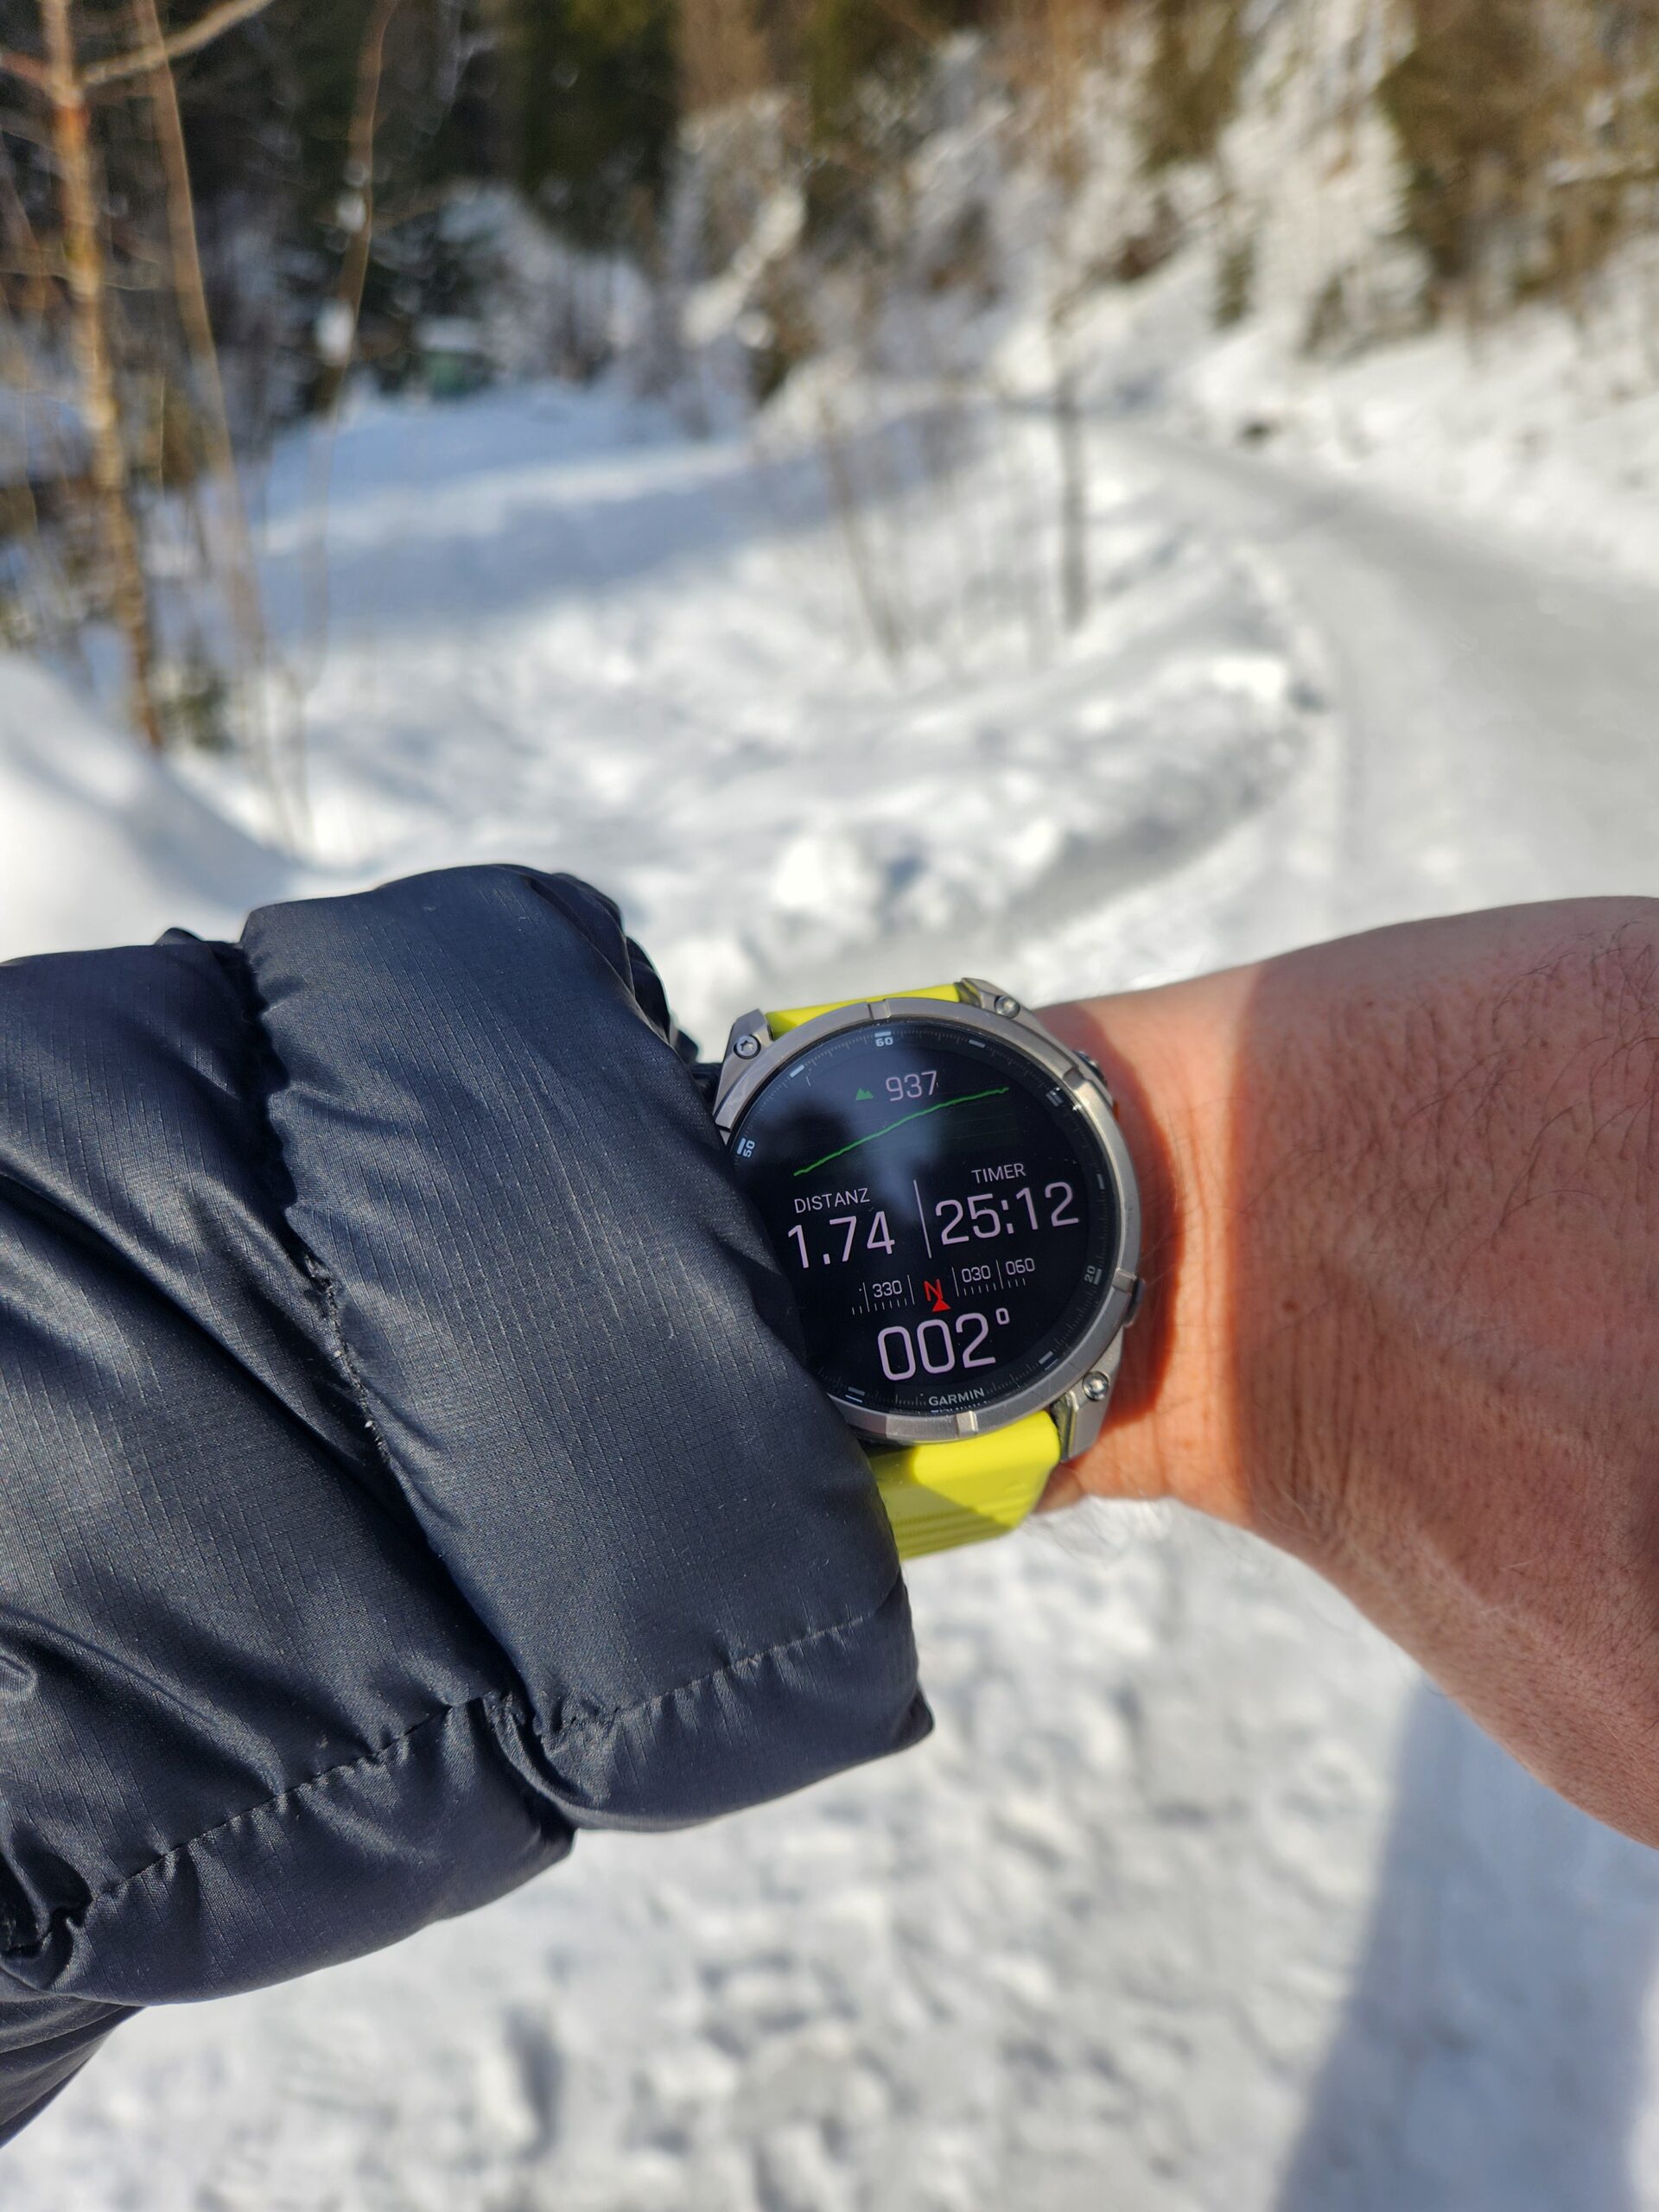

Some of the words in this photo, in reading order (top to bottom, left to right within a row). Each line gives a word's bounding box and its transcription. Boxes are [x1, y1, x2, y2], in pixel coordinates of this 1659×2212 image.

[875, 1037, 893, 1047] 60
[885, 1070, 938, 1102] 937
[742, 1140, 756, 1158] 50
[971, 1163, 1027, 1184] TIMER
[793, 1187, 870, 1213] DISTANZ
[935, 1181, 1079, 1245] 25:12
[787, 1211, 895, 1269] 1.74
[872, 1280, 903, 1297] 330
[923, 1279, 944, 1302] N
[961, 1265, 991, 1283] 030
[1005, 1257, 1036, 1275] 060
[1084, 1265, 1096, 1282] 20
[928, 1387, 985, 1407] GARMIN
